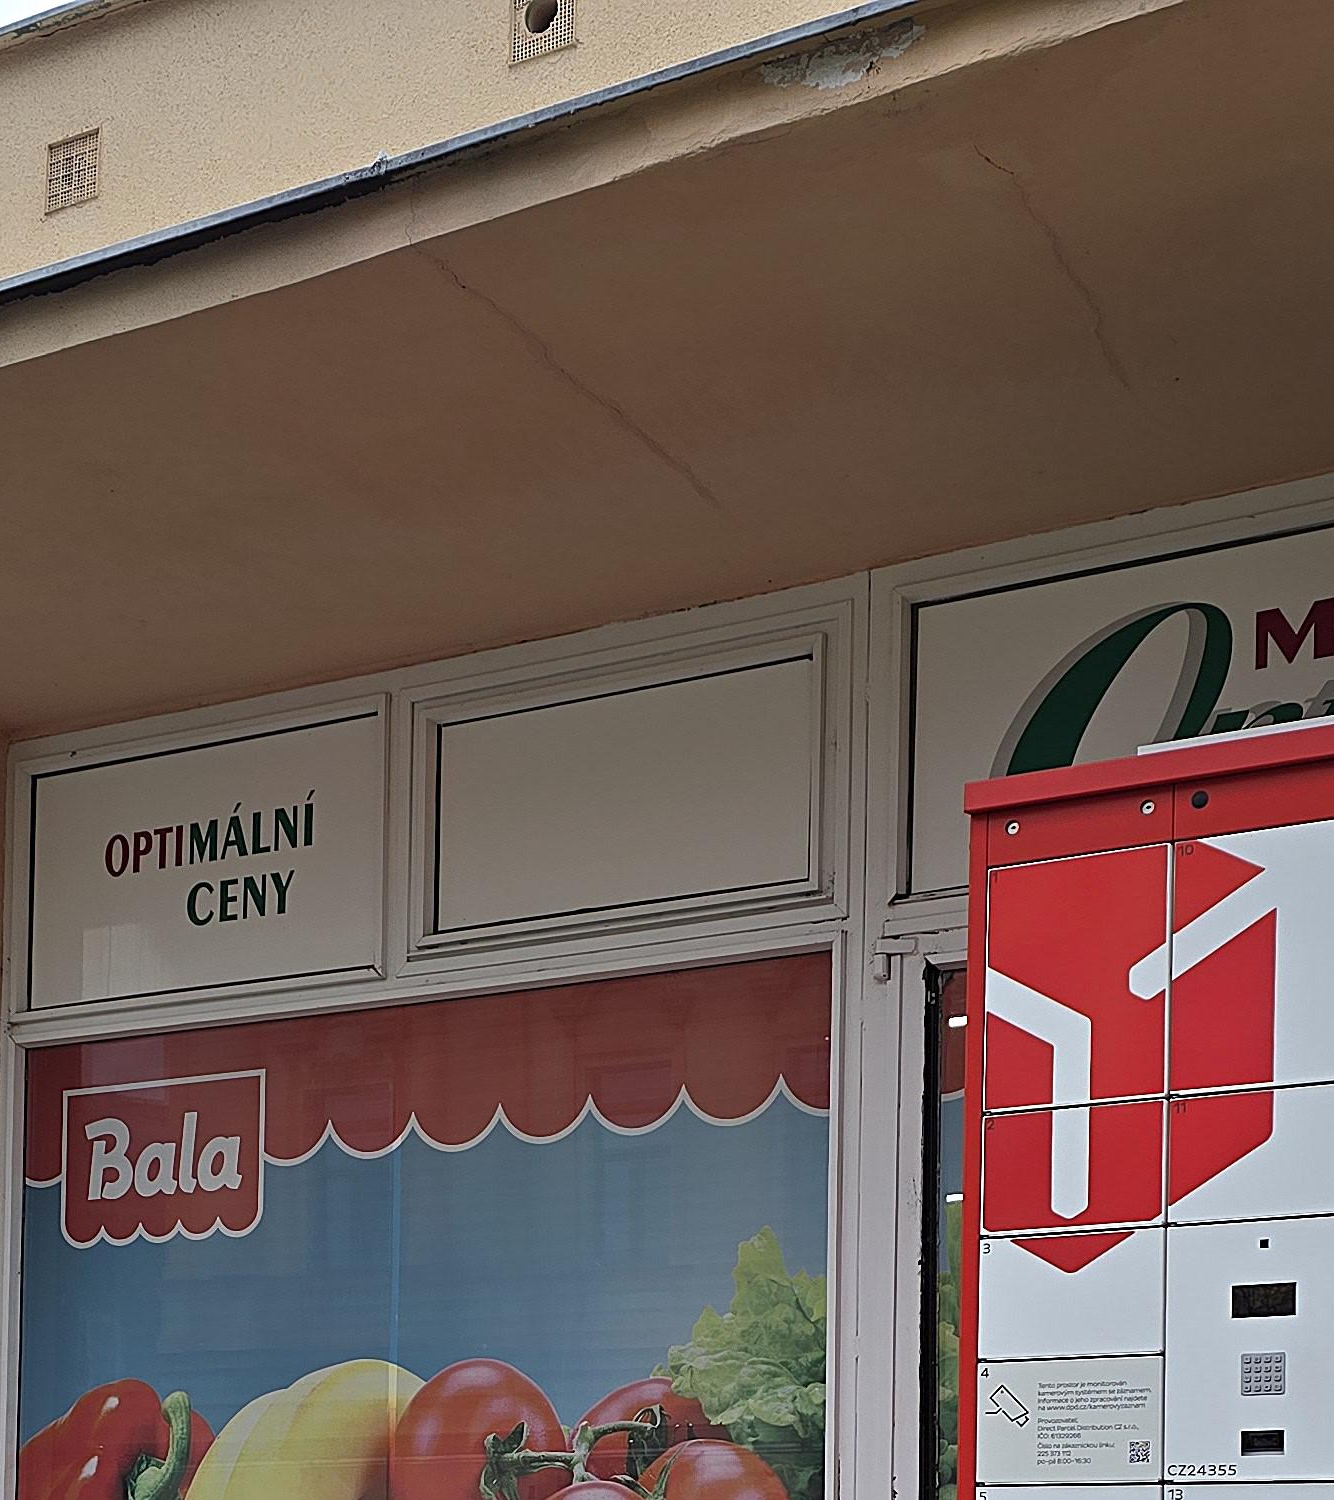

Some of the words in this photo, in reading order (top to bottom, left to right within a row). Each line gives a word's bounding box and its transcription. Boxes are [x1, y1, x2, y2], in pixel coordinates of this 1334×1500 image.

[105, 789, 315, 878] OPTIMÁLNÍ
[1178, 843, 1194, 856] 10
[186, 869, 295, 927] CENY
[85, 1110, 243, 1201] Bala
[982, 1243, 991, 1255] 3
[980, 1367, 989, 1379] 4
[1167, 1464, 1237, 1477] CZ24355
[1168, 1489, 1184, 1500] 13
